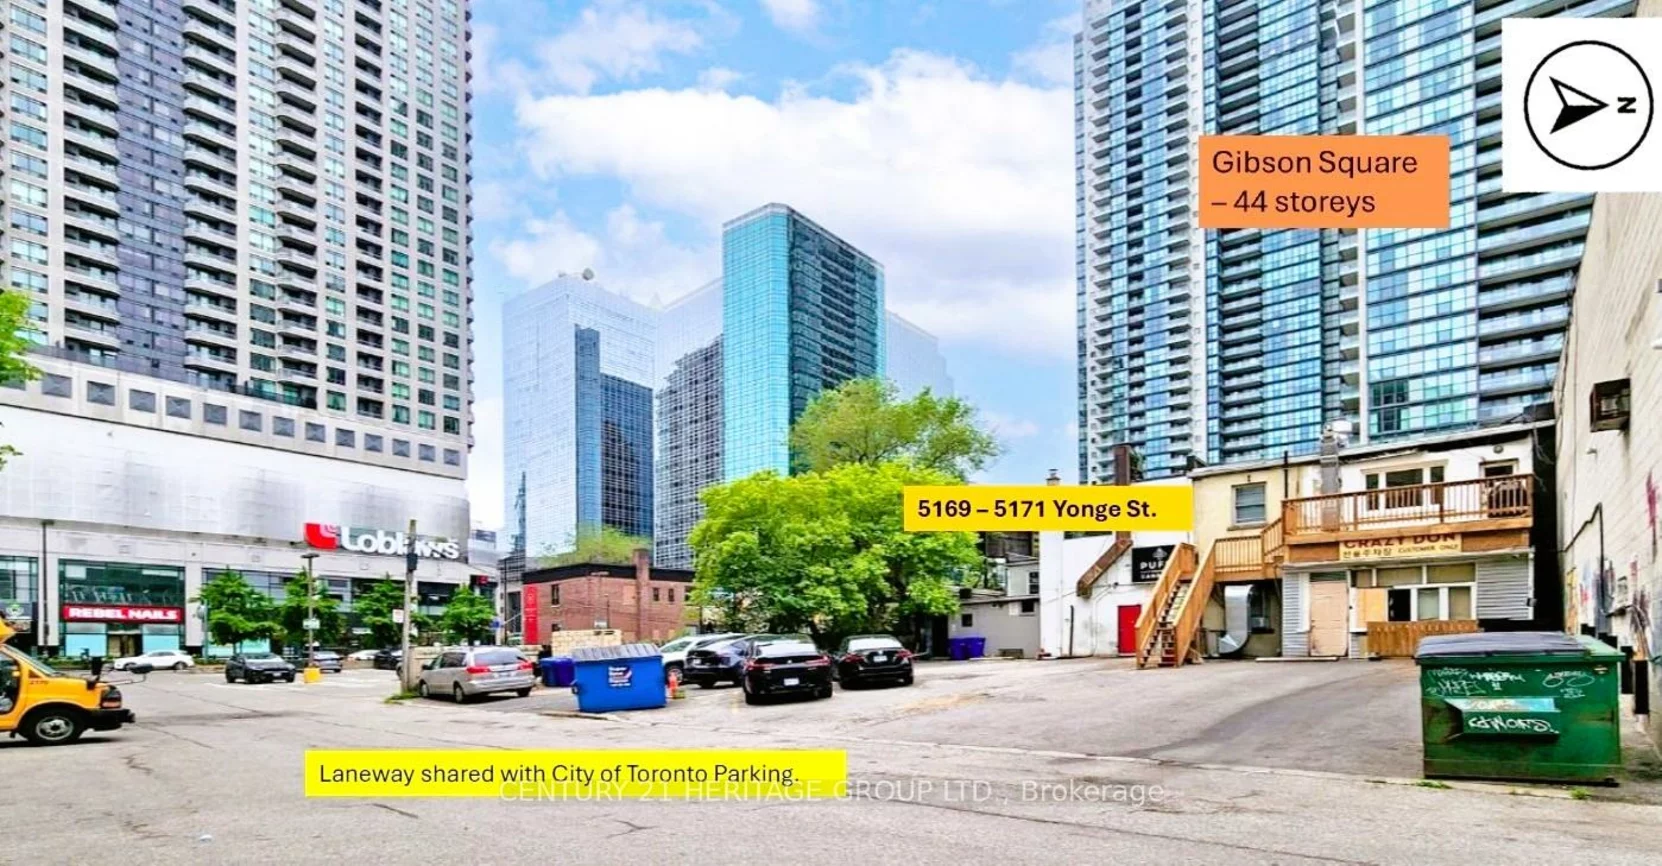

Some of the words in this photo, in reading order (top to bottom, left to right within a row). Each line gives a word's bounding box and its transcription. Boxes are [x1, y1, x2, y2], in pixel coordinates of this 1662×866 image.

[1140, 561, 1165, 569] PUF
[68, 607, 126, 618] REBEL
[128, 609, 178, 620] NAILS
